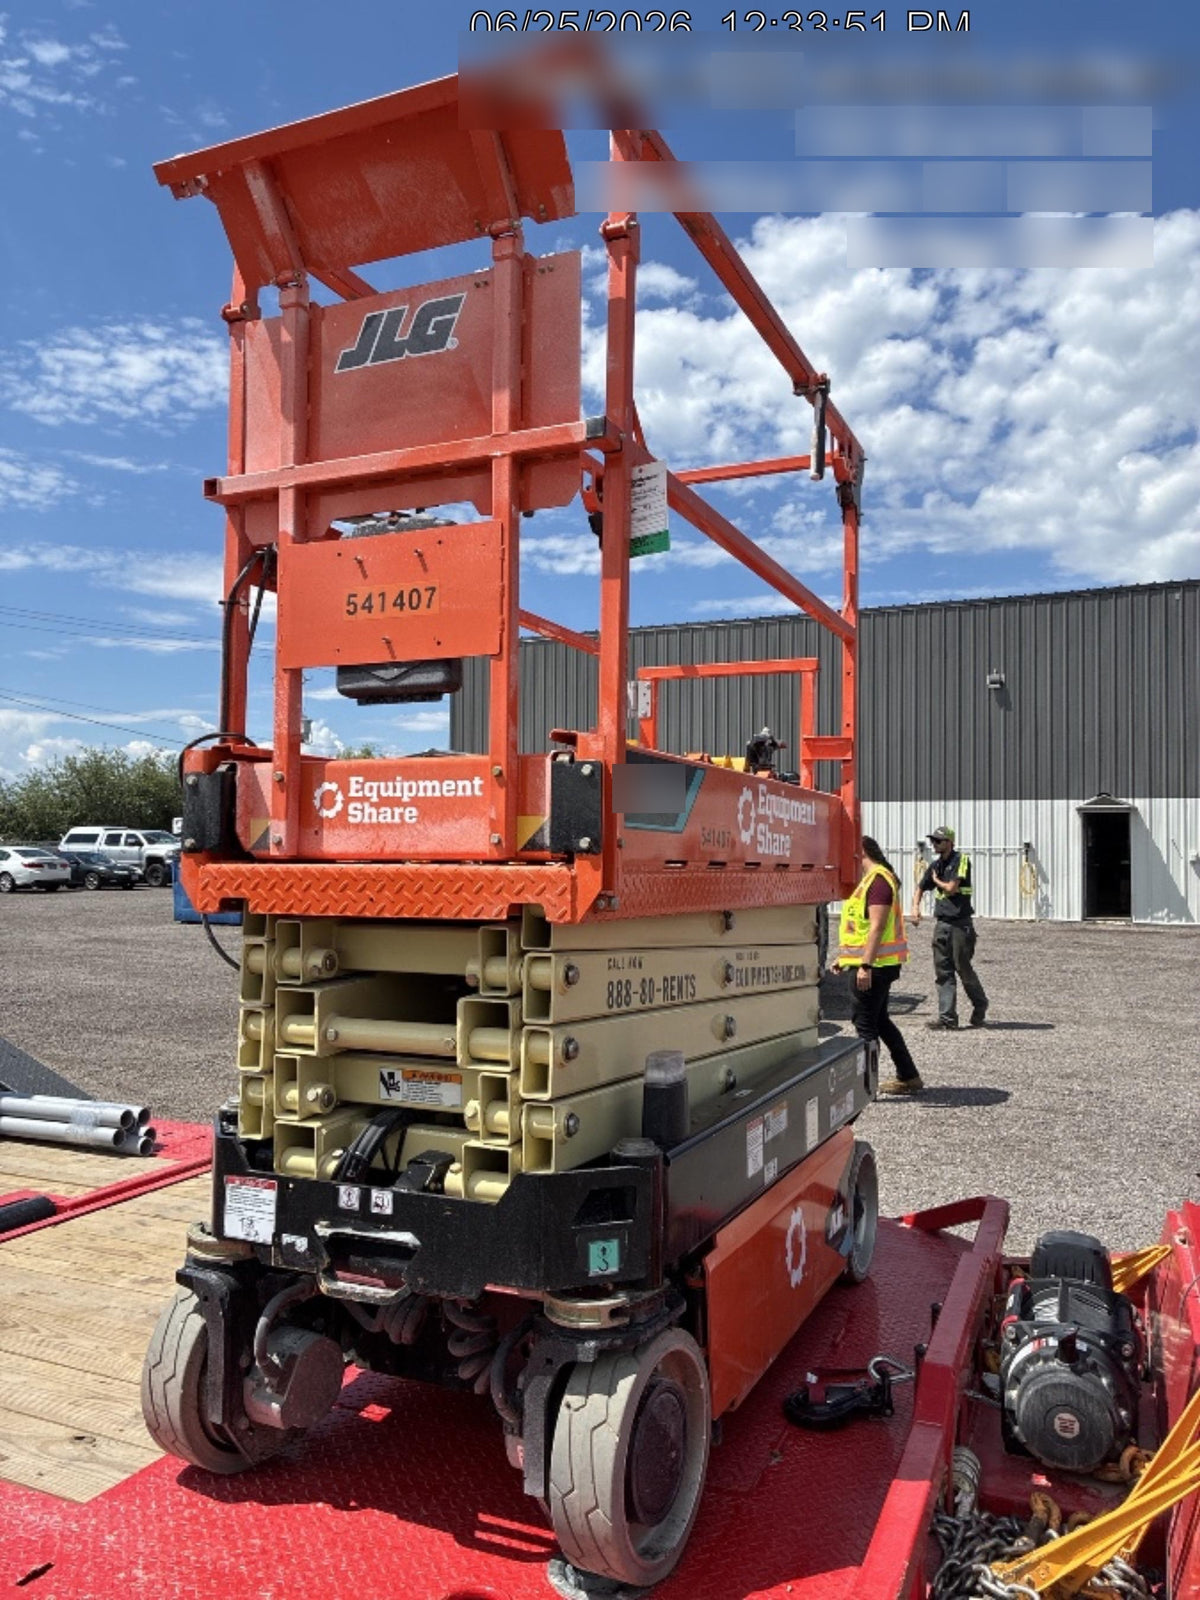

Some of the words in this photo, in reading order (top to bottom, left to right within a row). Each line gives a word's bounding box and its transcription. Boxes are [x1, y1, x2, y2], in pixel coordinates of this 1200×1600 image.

[334, 291, 467, 374] JLG
[346, 586, 437, 616] 541407
[348, 776, 484, 802] Equipment
[757, 783, 817, 828] Equipment
[347, 801, 419, 824] Share
[756, 822, 792, 858] Share
[607, 973, 697, 1010] 888-80-RENTS
